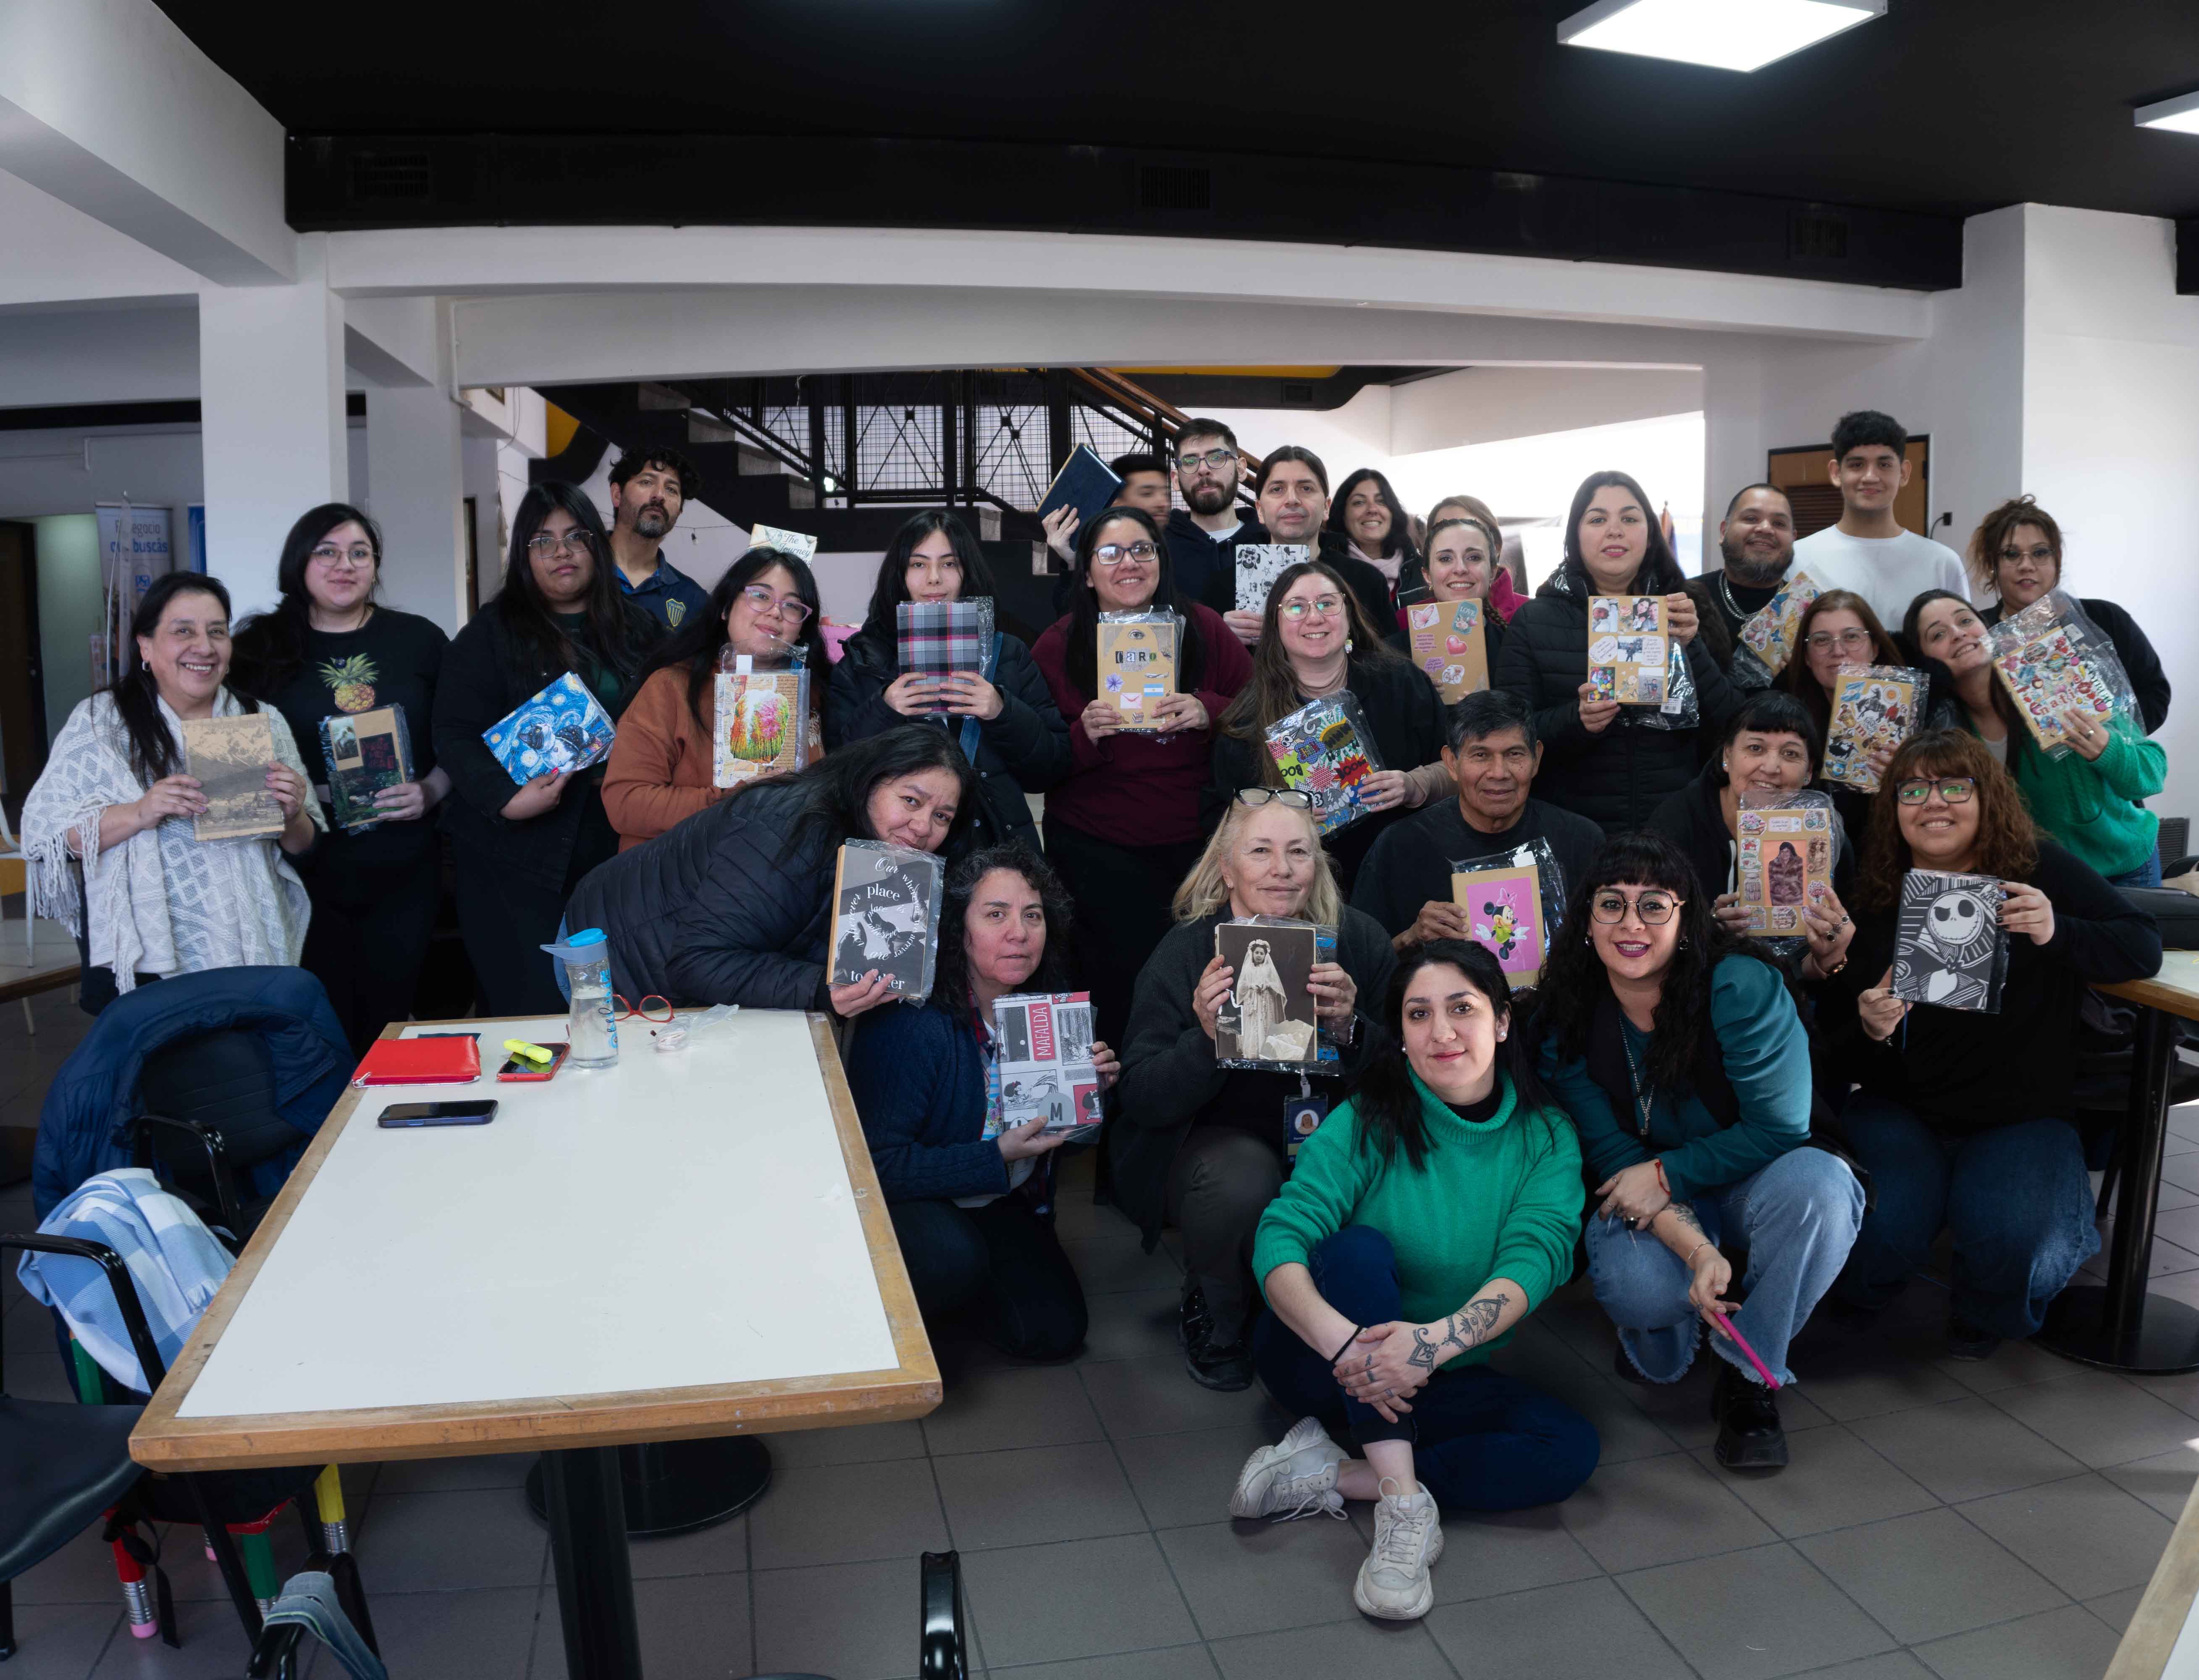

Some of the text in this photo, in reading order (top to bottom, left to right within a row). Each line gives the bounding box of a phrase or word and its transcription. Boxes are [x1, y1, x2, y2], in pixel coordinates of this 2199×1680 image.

[131, 520, 161, 538] egocio
[132, 538, 168, 553] buscás
[784, 533, 799, 544] The
[780, 543, 811, 558] Journey
[1459, 606, 1476, 617] LOVE
[875, 856, 899, 874] Our
[866, 883, 900, 900] place
[867, 903, 887, 923] place
[1031, 1006, 1052, 1056] MAFALDA
[1050, 1102, 1063, 1121] M
